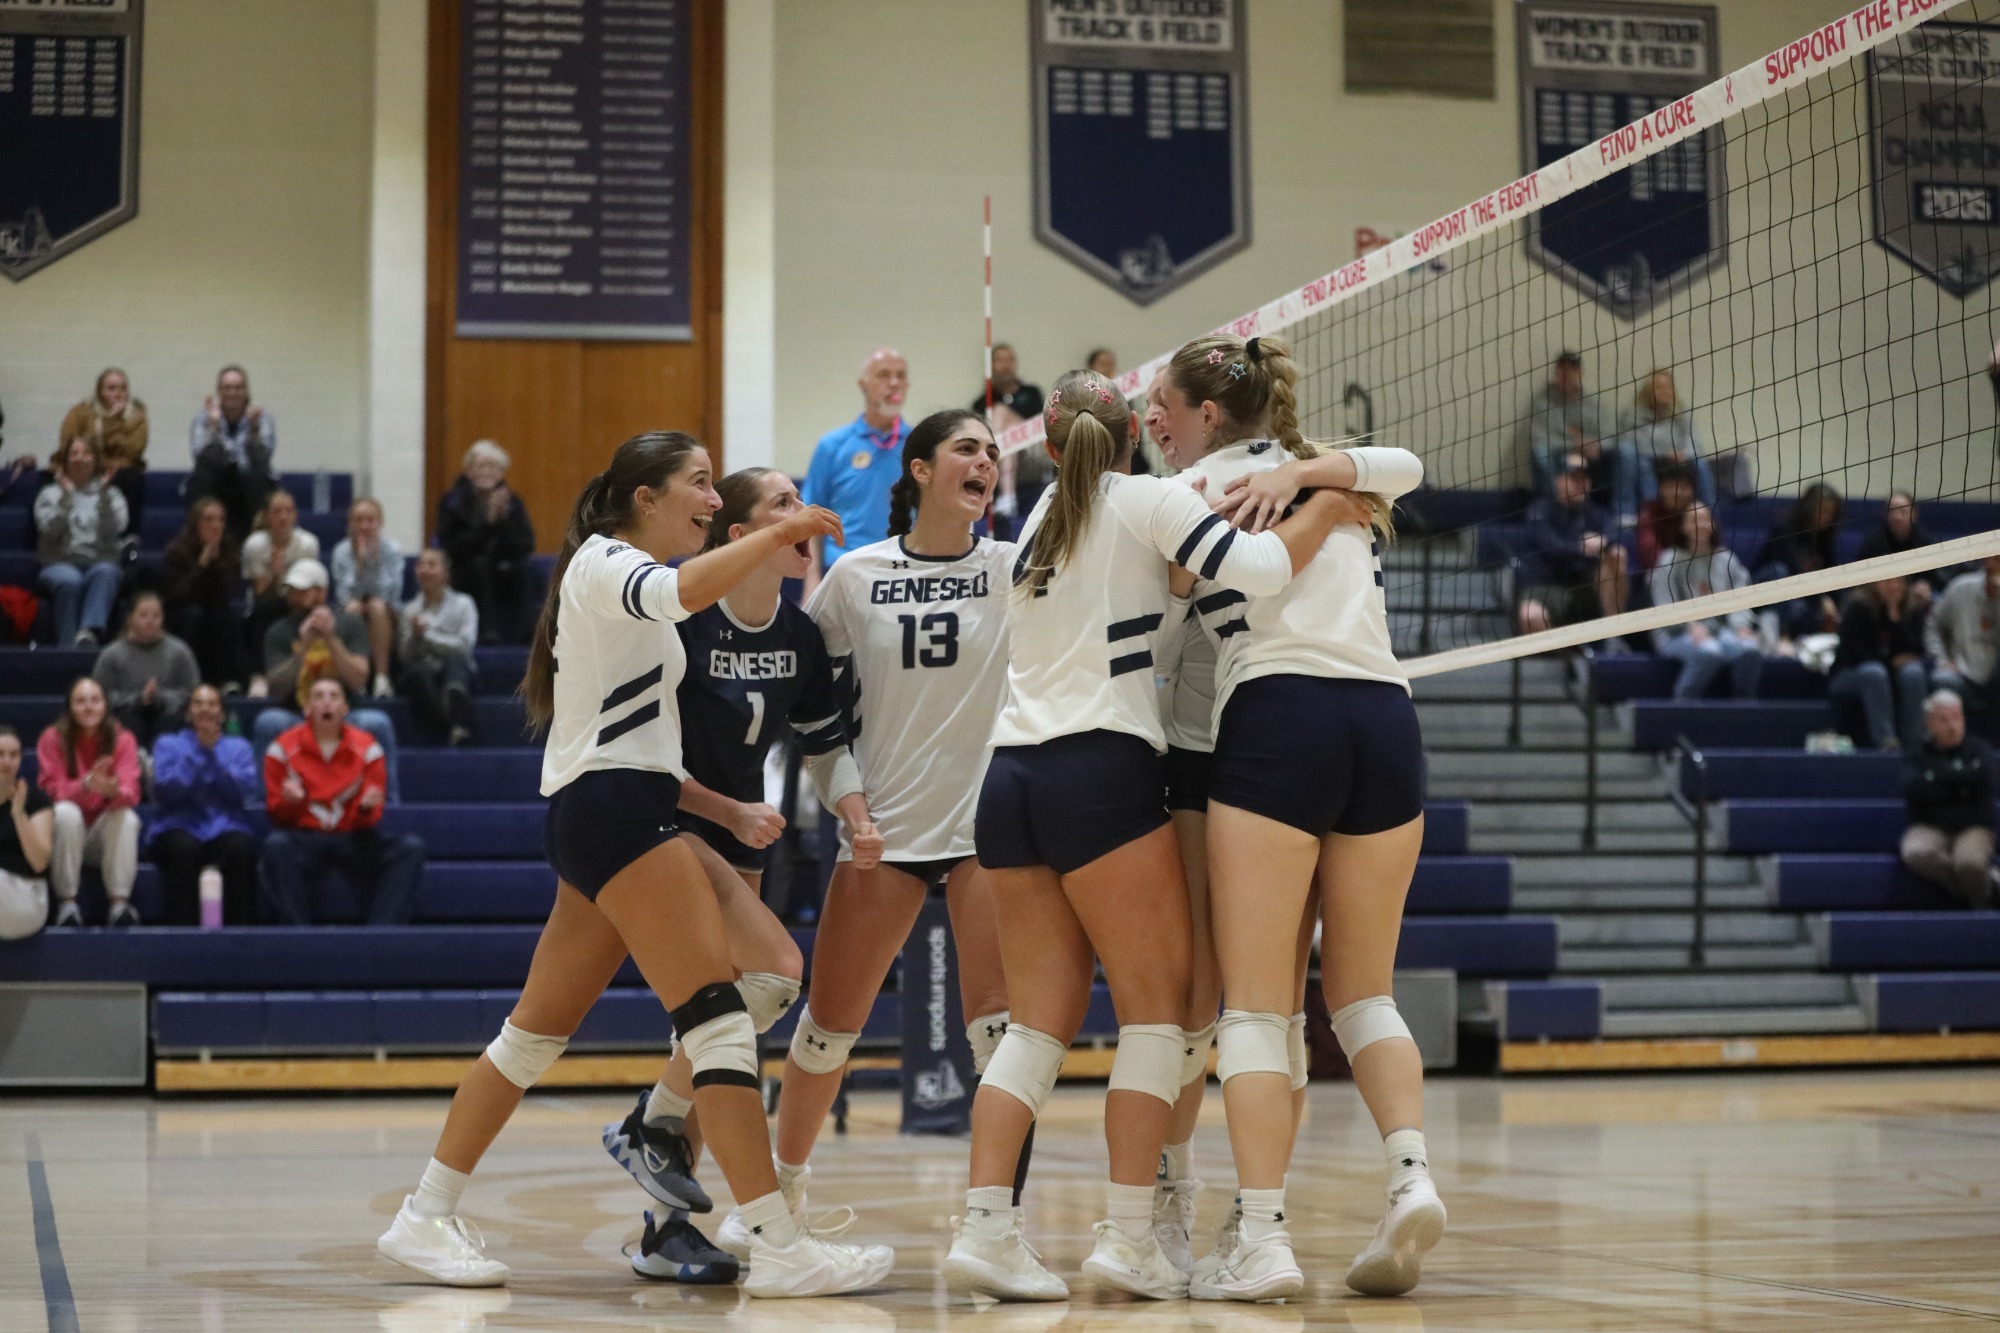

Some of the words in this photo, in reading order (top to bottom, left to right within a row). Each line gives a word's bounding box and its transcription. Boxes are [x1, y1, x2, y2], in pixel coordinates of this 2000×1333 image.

[1057, 16, 1130, 39] TRACK
[1160, 21, 1221, 44] FIELD
[1544, 41, 1610, 63] TRACK
[1639, 46, 1696, 69] FIELD
[1765, 18, 1847, 85] SUPPORT
[1853, 0, 1893, 41] THE
[1600, 125, 1637, 166] FIND
[1641, 117, 1653, 146] A
[1655, 95, 1696, 138] CURE
[1413, 209, 1468, 257] SUPPORT
[1471, 194, 1496, 229] THE
[1498, 173, 1539, 215] FIGHT
[1302, 275, 1326, 308] FIND
[1329, 273, 1338, 297] A
[1339, 259, 1367, 291] CURE
[871, 571, 988, 604] GENESEO
[709, 649, 797, 680] GENESEO
[898, 612, 959, 669] 13
[744, 692, 765, 745] 1
